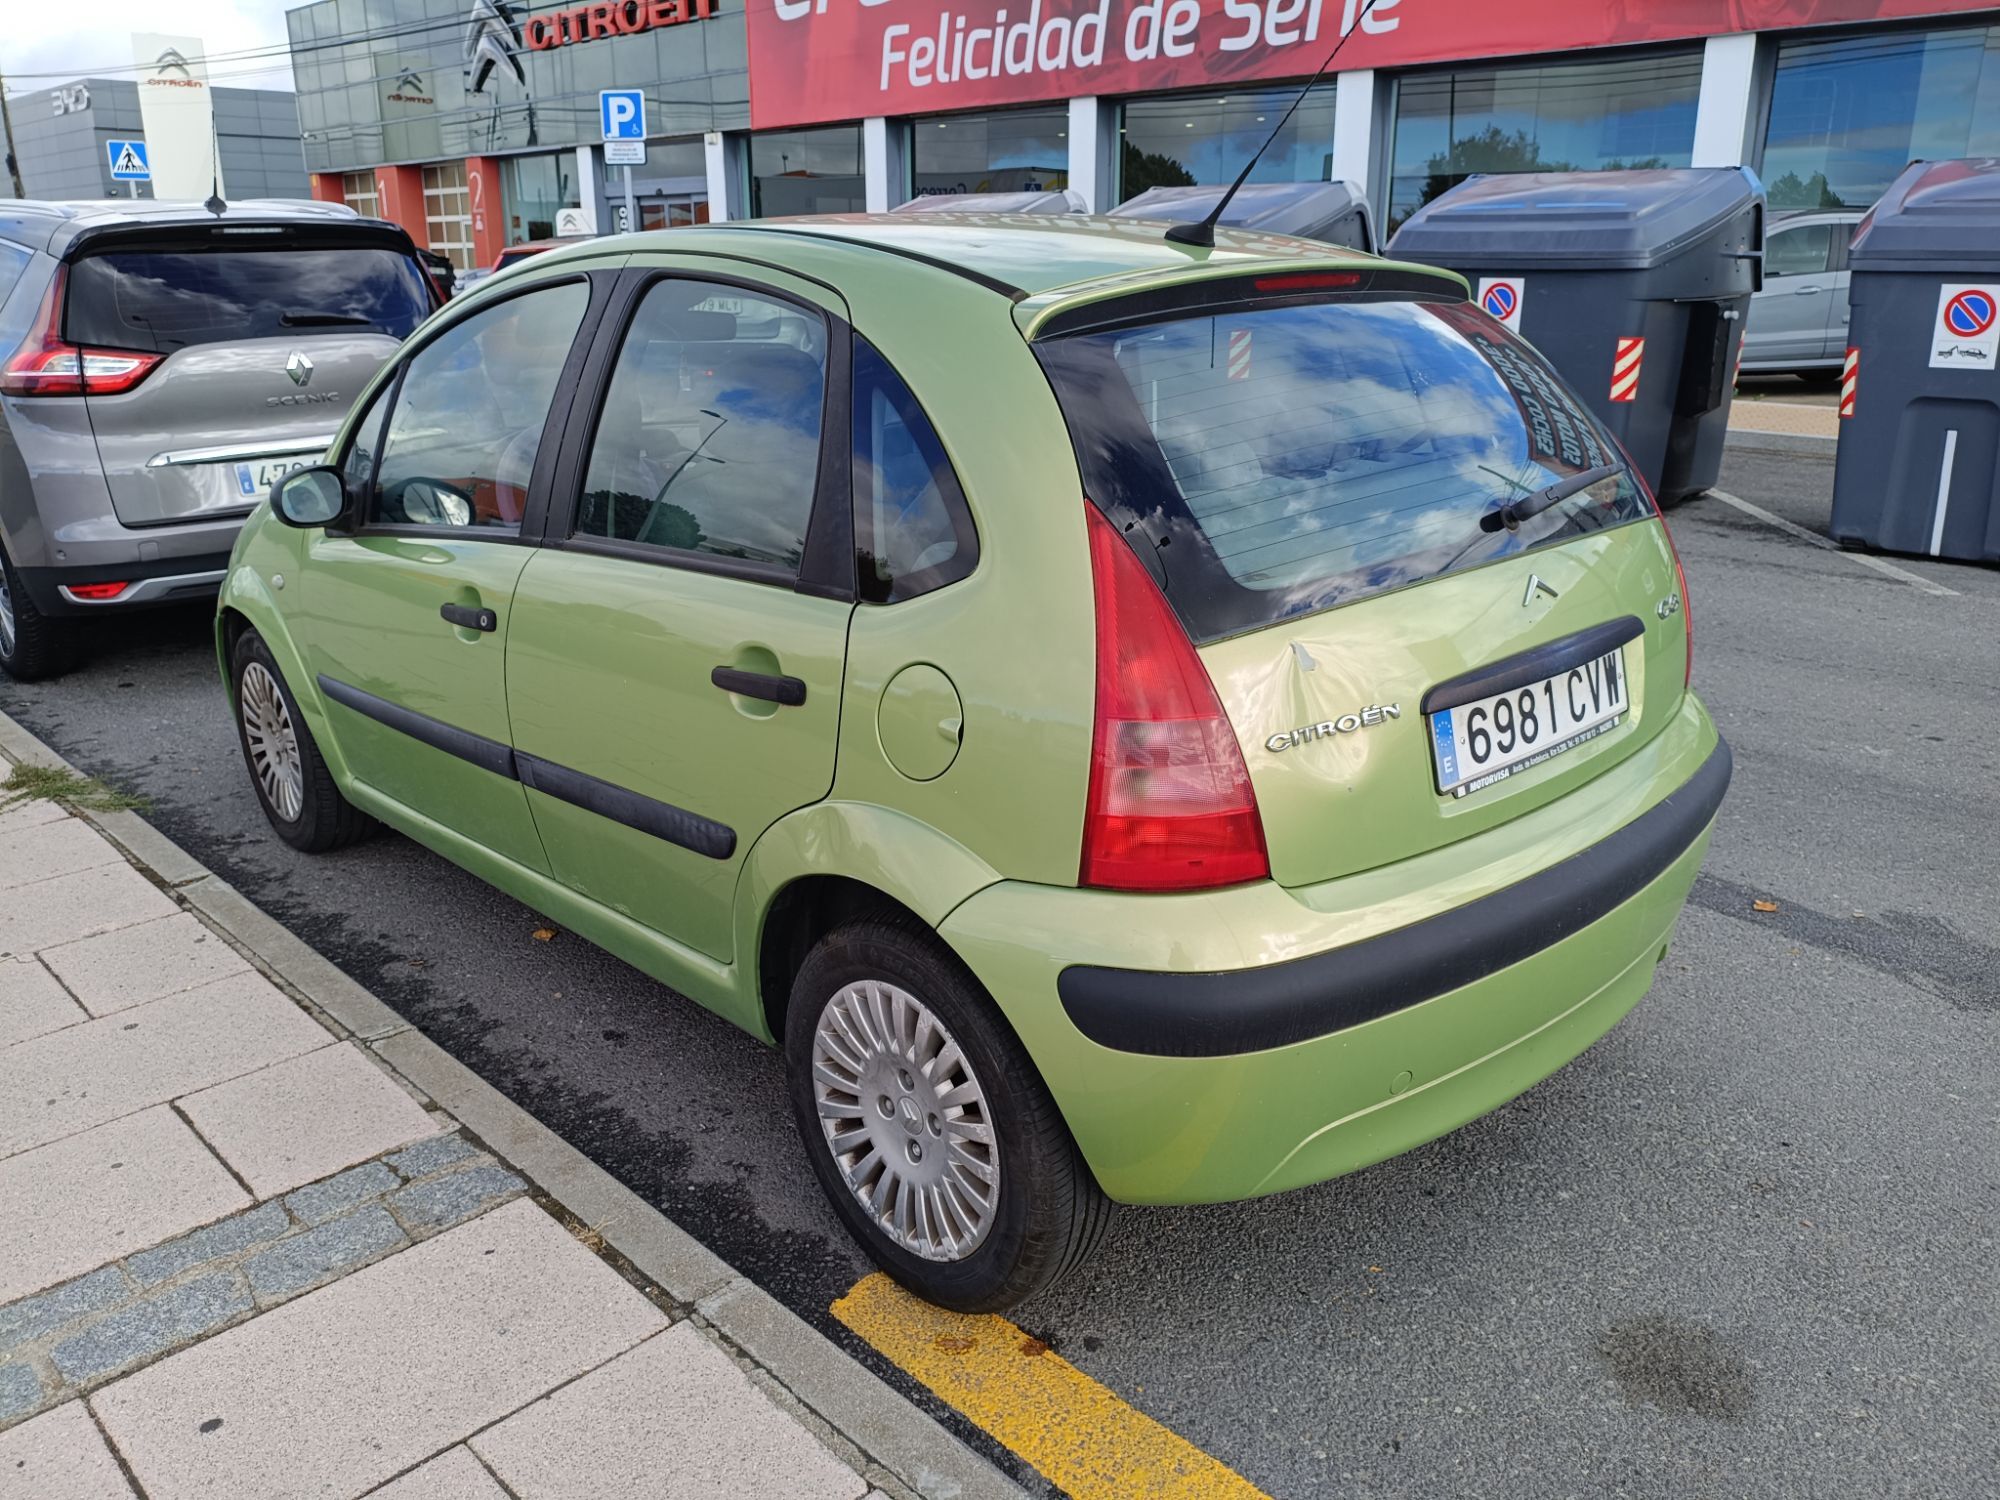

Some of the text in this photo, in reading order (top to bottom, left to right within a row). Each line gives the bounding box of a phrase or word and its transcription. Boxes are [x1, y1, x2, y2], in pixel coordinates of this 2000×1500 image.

[880, 0, 1401, 91] Felicidad de Serie
[378, 179, 389, 217] 1
[469, 171, 484, 213] 2
[266, 391, 340, 408] SCENIC
[1265, 703, 1401, 752] CITROËN
[1443, 756, 1454, 773] E
[1467, 679, 1558, 764] 6981
[1567, 652, 1620, 723] CVW
[1469, 769, 1510, 793] MOTORVISA
